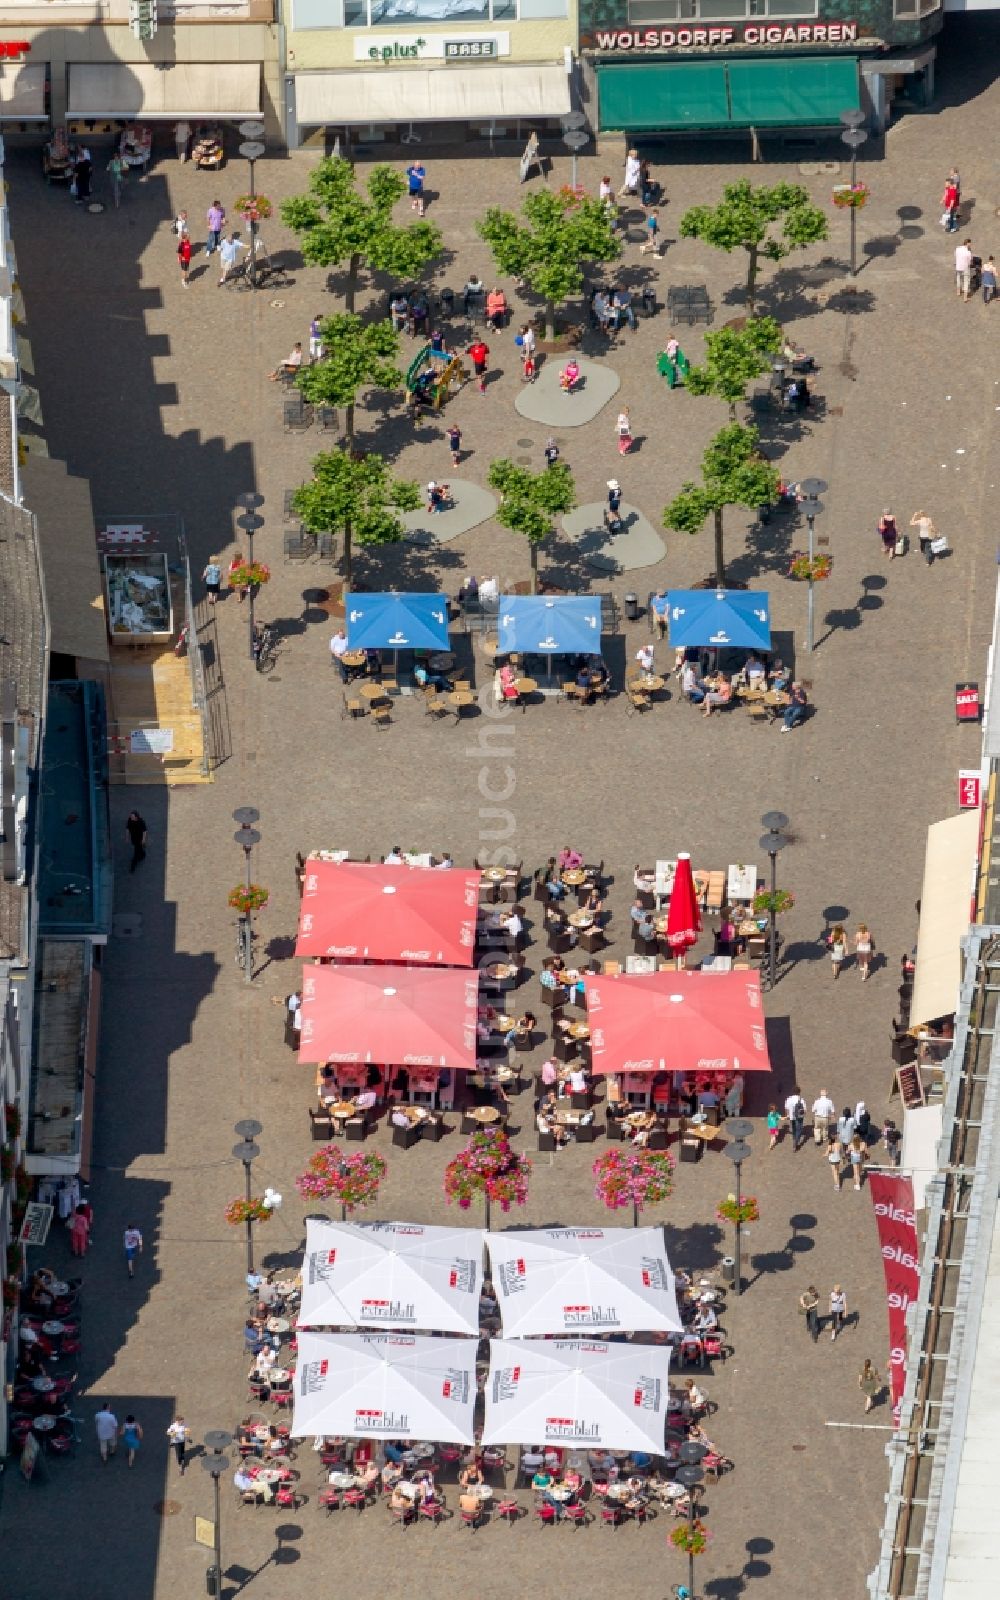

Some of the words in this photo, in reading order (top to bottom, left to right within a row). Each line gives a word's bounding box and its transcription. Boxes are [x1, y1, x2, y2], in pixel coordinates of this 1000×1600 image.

[597, 28, 735, 49] WOLSDORFF
[744, 22, 858, 44] CIGARREN
[448, 43, 493, 56] BASE
